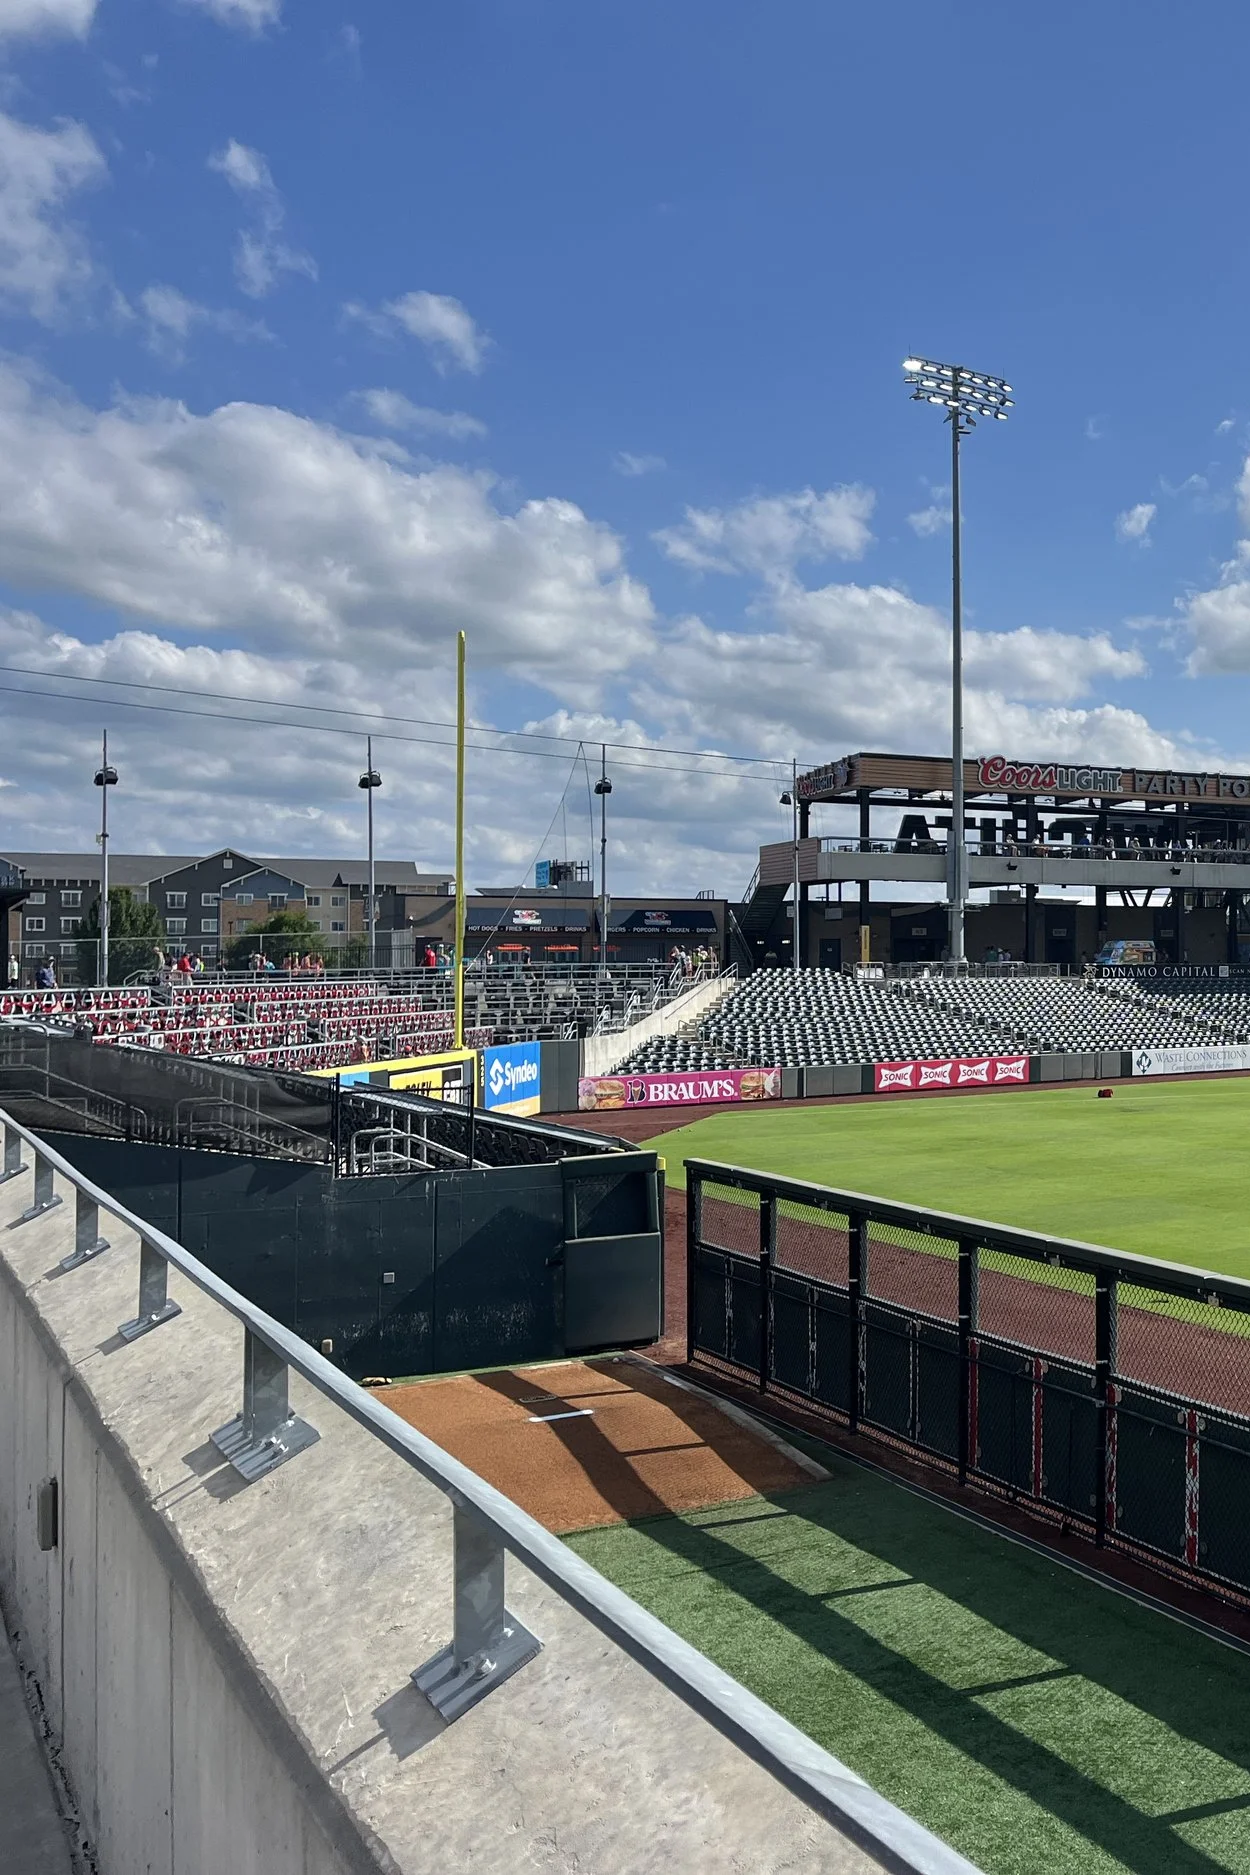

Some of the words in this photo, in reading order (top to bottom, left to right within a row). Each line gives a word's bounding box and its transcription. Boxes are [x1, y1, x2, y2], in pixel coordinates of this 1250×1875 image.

[977, 755, 1057, 792] Coors
[1056, 766, 1122, 793] LIGHT
[1135, 772, 1210, 796] PARTY
[1102, 966, 1157, 978] DYNAMO
[1162, 966, 1216, 977] CAPITAL
[1154, 1051, 1183, 1064] WASTE
[1185, 1049, 1247, 1063] CONNECTIONS
[504, 1059, 538, 1091] Syndeo
[923, 1070, 948, 1080] SONIC
[961, 1067, 985, 1077] SONIC
[998, 1065, 1022, 1075] SONIC
[883, 1072, 909, 1082] SONIC
[648, 1078, 735, 1102] BRAUM'S
